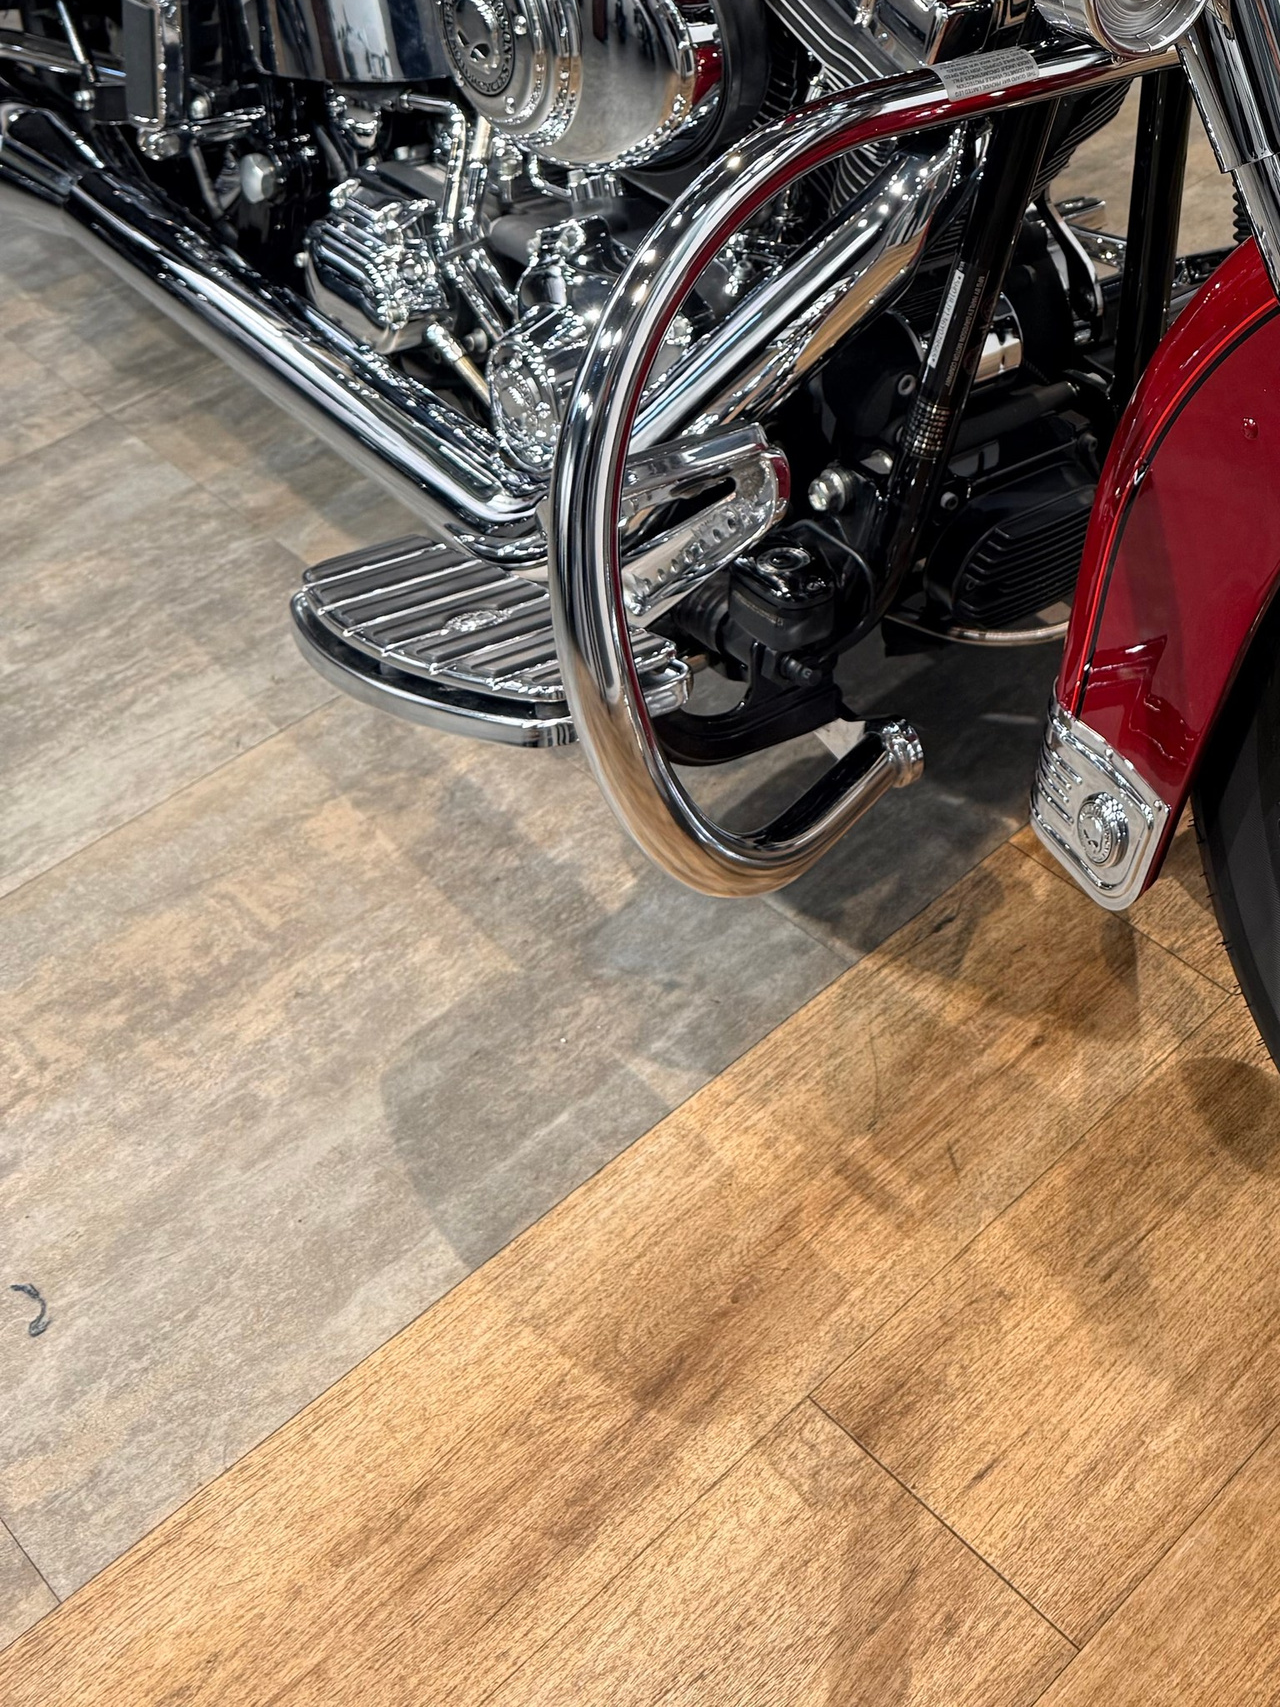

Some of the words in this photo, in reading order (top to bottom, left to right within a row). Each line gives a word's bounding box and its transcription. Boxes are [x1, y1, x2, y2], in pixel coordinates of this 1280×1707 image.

[1003, 68, 1025, 77] COSMETIC
[985, 74, 1003, 82] VEHICLE
[956, 79, 985, 90] PROTECTION
[982, 81, 1002, 90] PROVIDE
[964, 86, 982, 95] LIMITED
[958, 295, 979, 342] HARLEY-DAVIDSON
[952, 342, 963, 361] MOTOR
[944, 361, 957, 387] COMPANY
